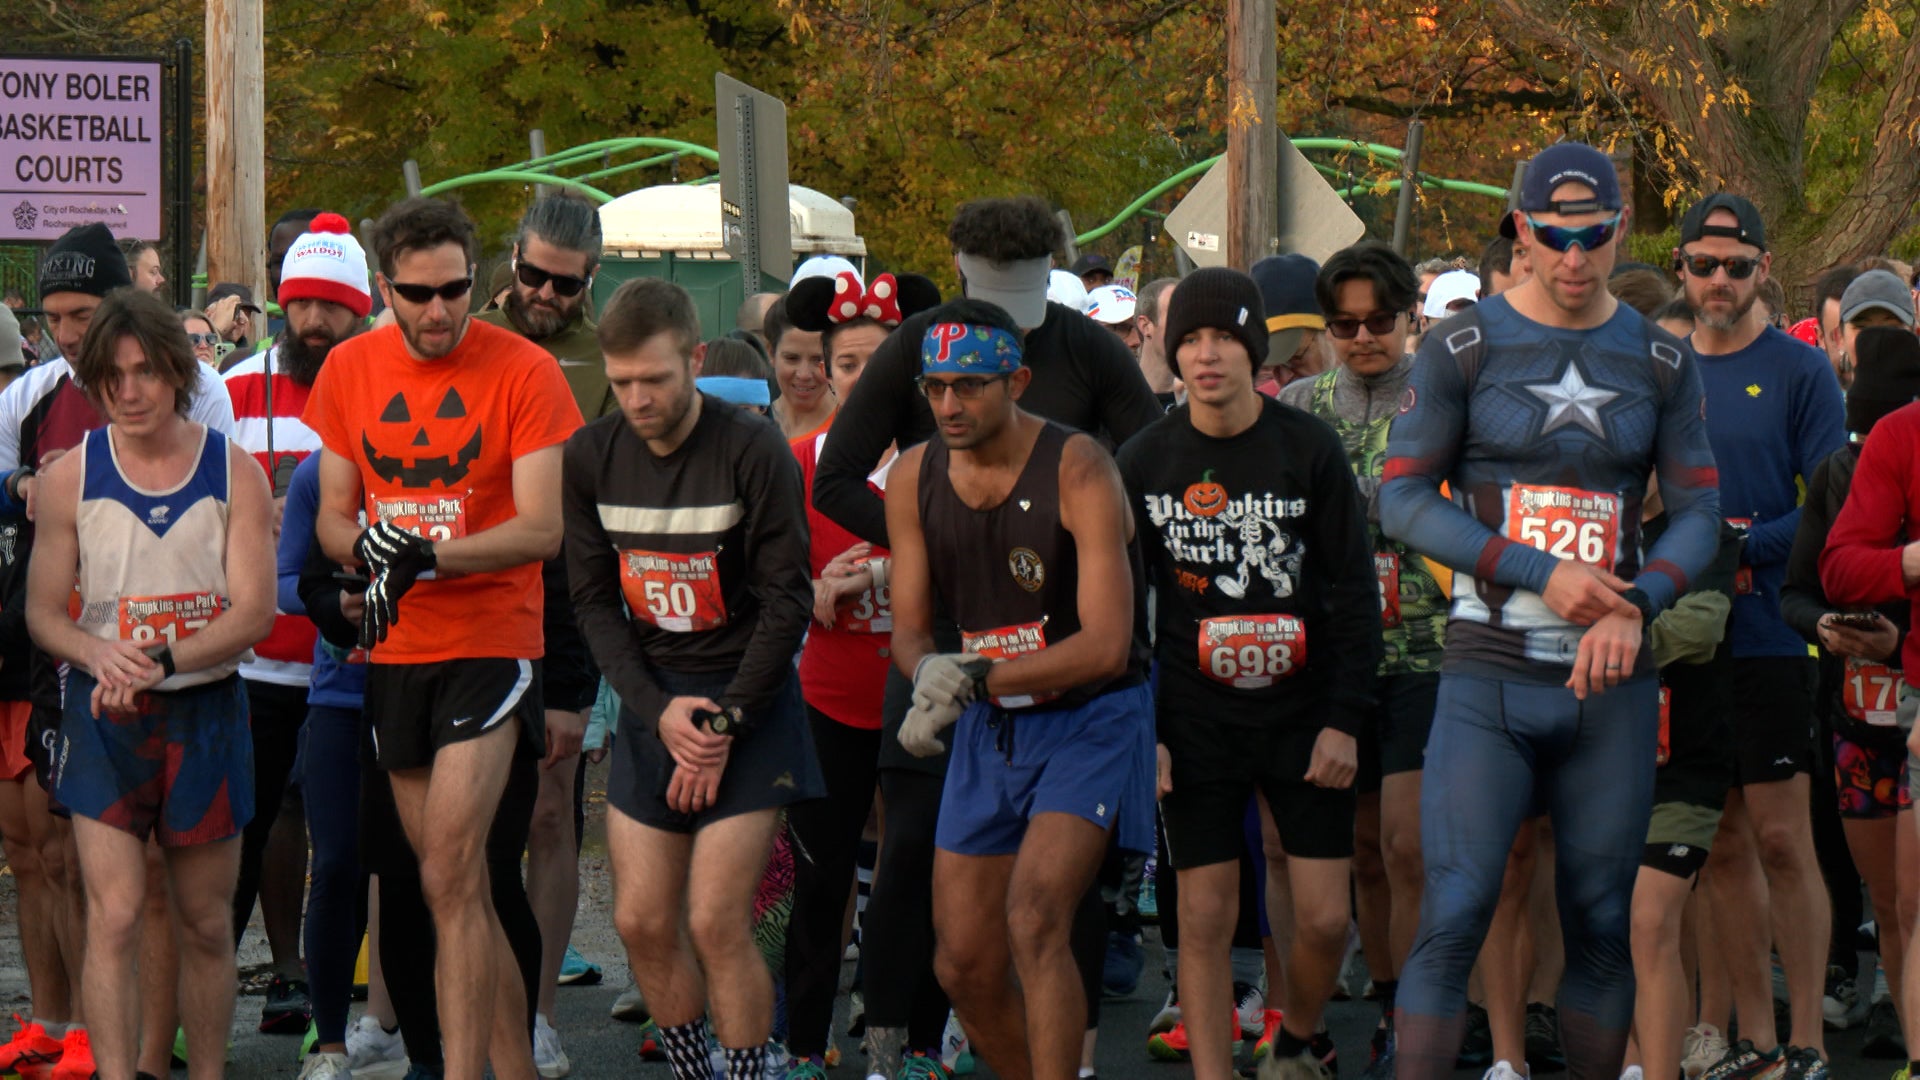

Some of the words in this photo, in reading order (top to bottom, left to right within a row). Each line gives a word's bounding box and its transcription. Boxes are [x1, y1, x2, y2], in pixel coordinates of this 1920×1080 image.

[66, 73, 150, 101] BOLER
[0, 113, 151, 142] ASKETBALL
[15, 155, 123, 184] COURTS
[43, 205, 59, 215] City
[60, 205, 68, 213] of
[439, 498, 462, 514] Park
[1145, 493, 1308, 527] Pupkins
[1594, 495, 1616, 513] Park
[1168, 520, 1190, 539] in
[1193, 519, 1226, 542] the
[1521, 517, 1605, 563] 526
[690, 557, 715, 572] Park
[196, 593, 218, 608] Park
[644, 581, 696, 618] 50
[1018, 626, 1042, 643] Park
[1278, 617, 1301, 633] Park
[1211, 643, 1293, 679] 698
